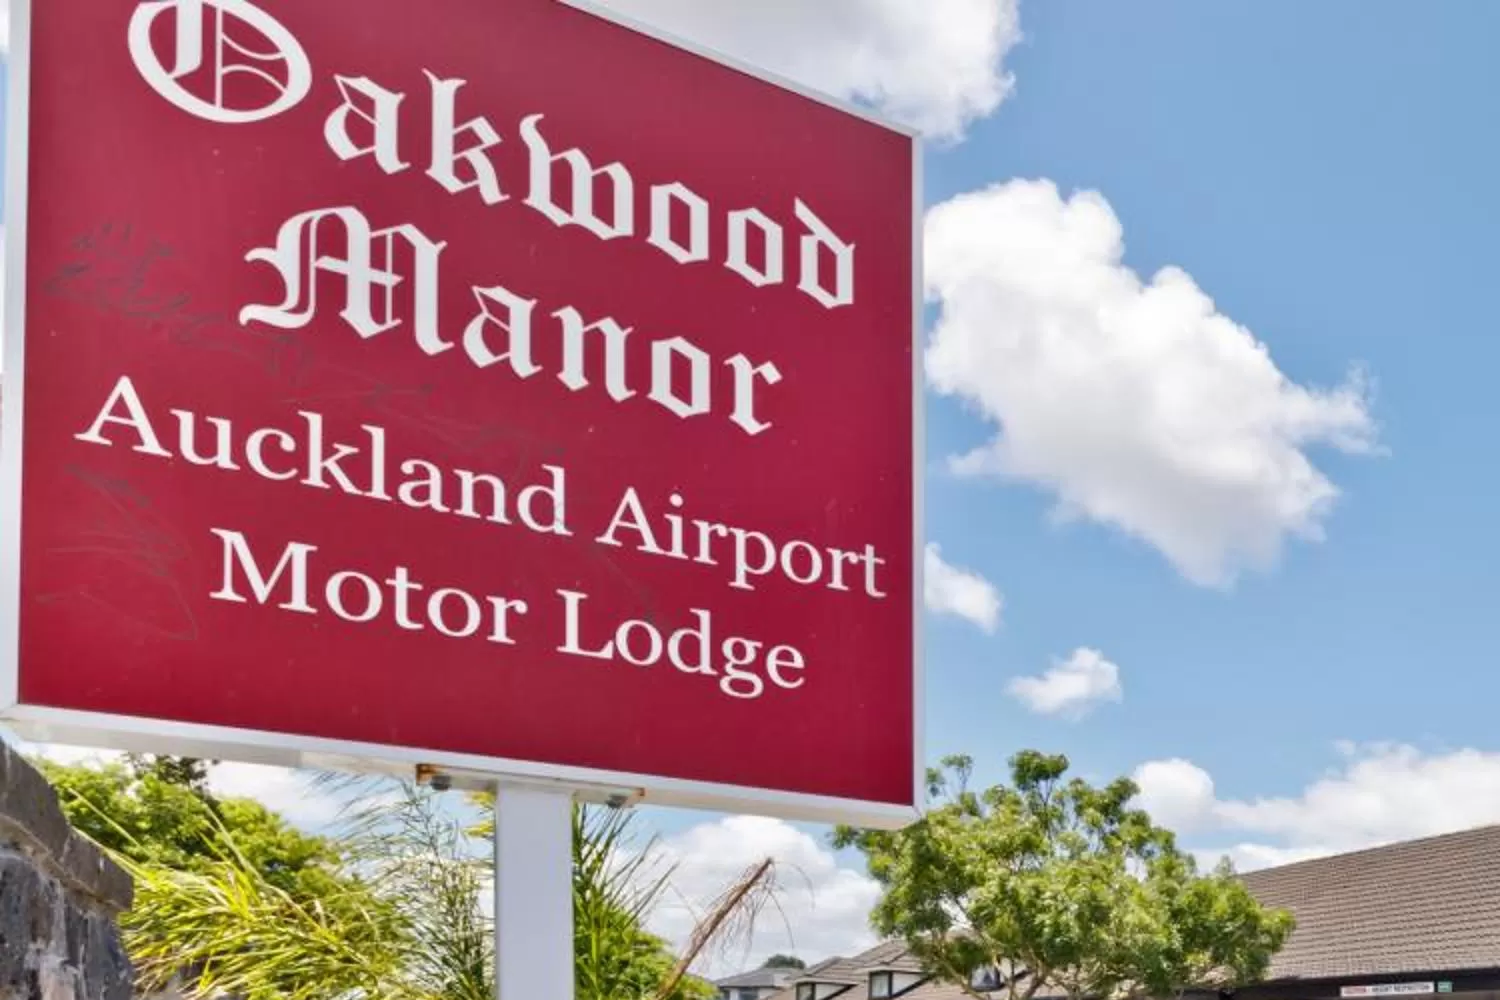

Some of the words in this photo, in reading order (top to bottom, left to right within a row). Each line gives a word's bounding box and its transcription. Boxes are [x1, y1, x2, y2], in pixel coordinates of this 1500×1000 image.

[128, 0, 855, 309] Oakwood
[240, 206, 782, 435] Manor
[75, 375, 572, 535] Auckland
[596, 487, 887, 598] Airport
[210, 527, 528, 644] Motor
[557, 589, 806, 698] Lodge
